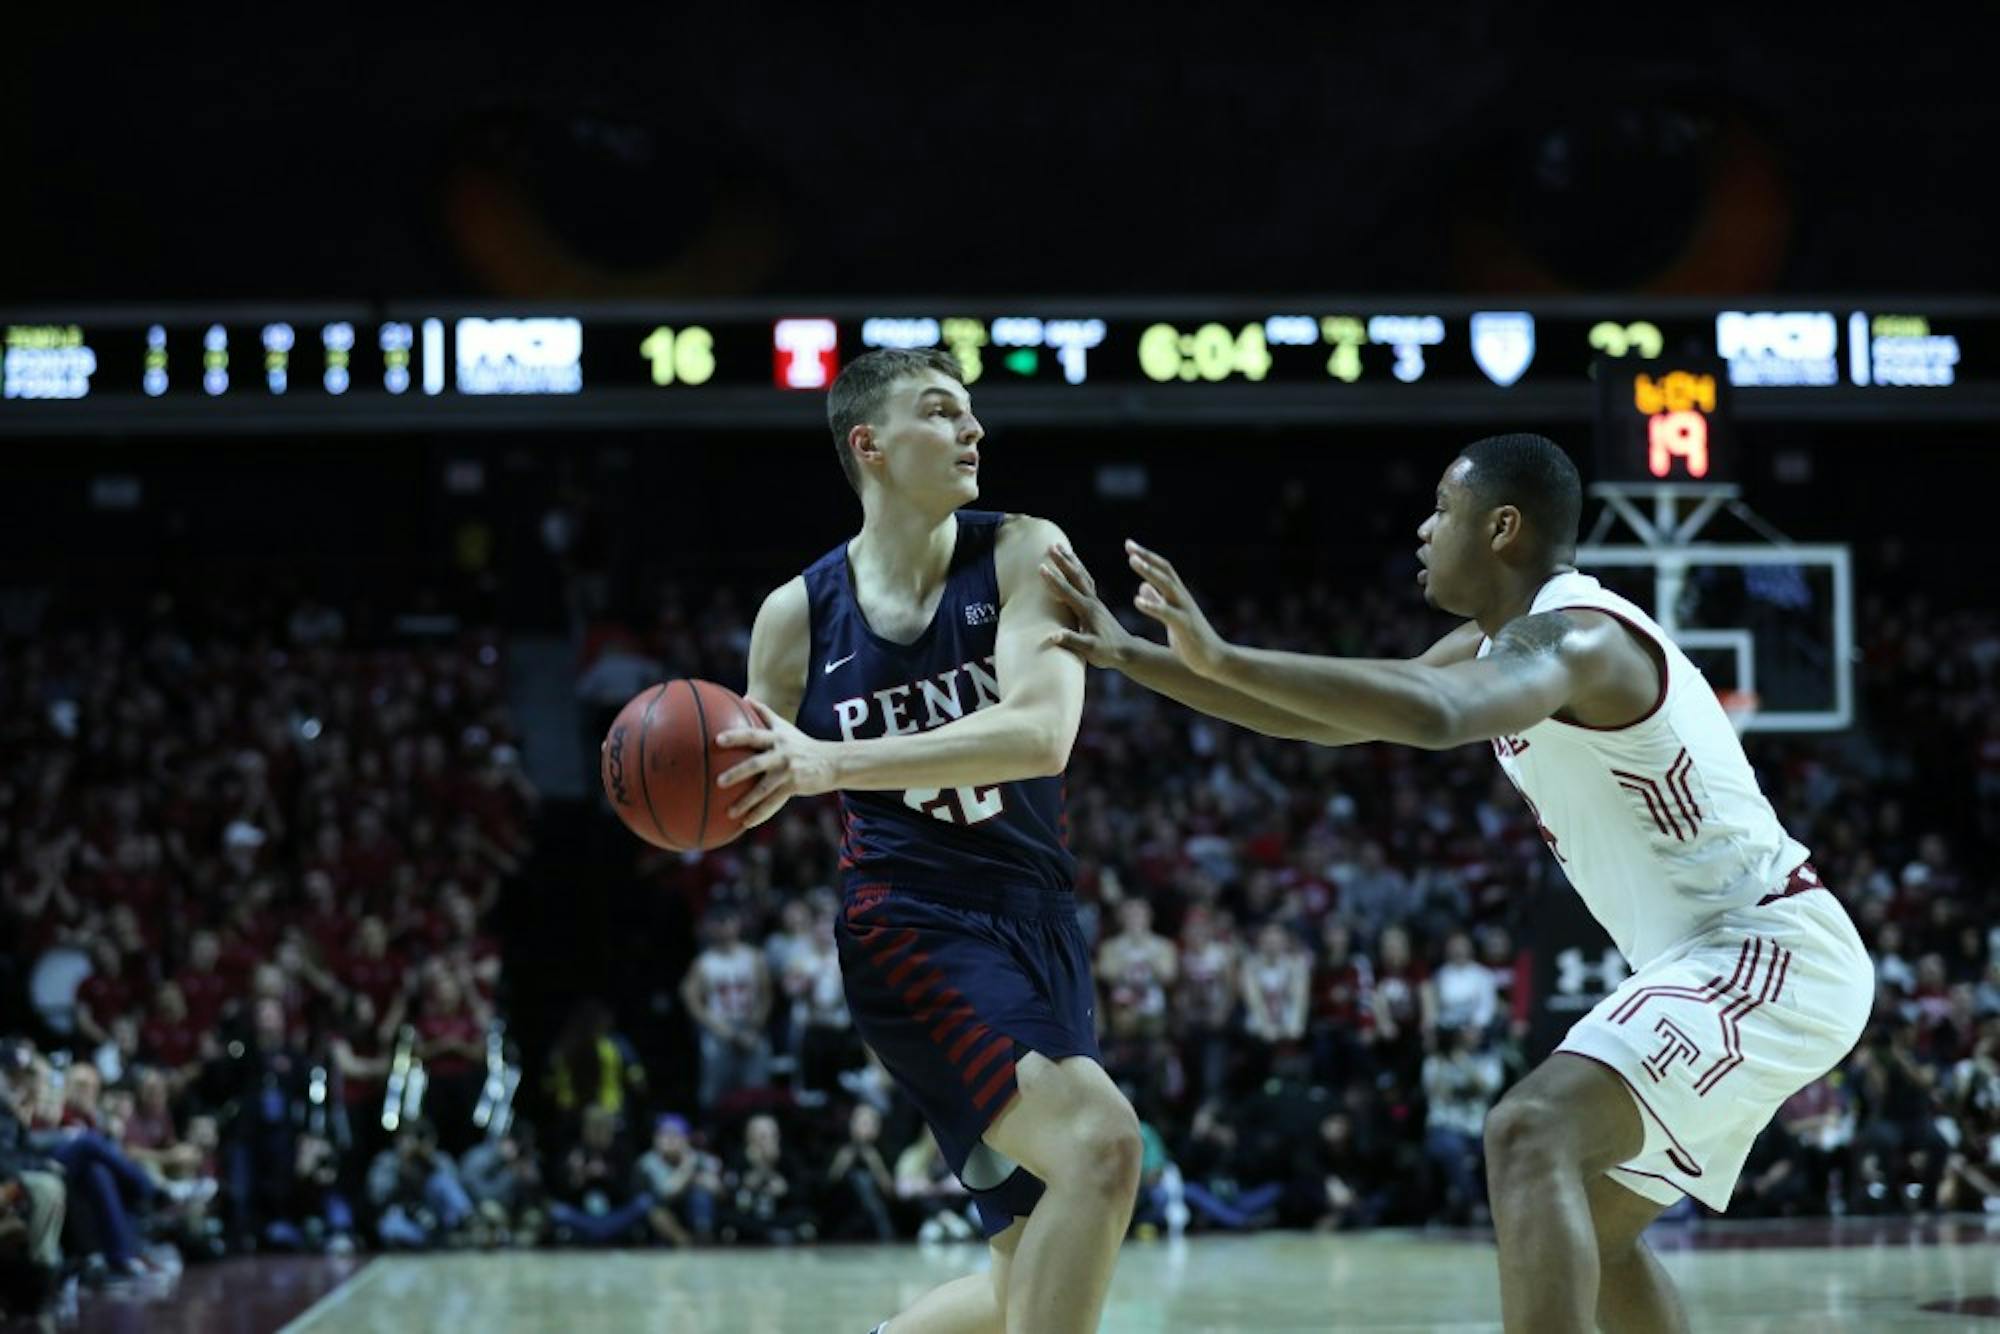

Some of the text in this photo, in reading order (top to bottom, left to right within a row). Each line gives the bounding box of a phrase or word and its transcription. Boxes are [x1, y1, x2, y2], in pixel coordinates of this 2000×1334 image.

[640, 325, 715, 386] 16
[1138, 323, 1272, 382] 6:04
[1649, 411, 1708, 478] 19
[833, 655, 1001, 743] PENN
[1641, 1017, 1701, 1083] T
